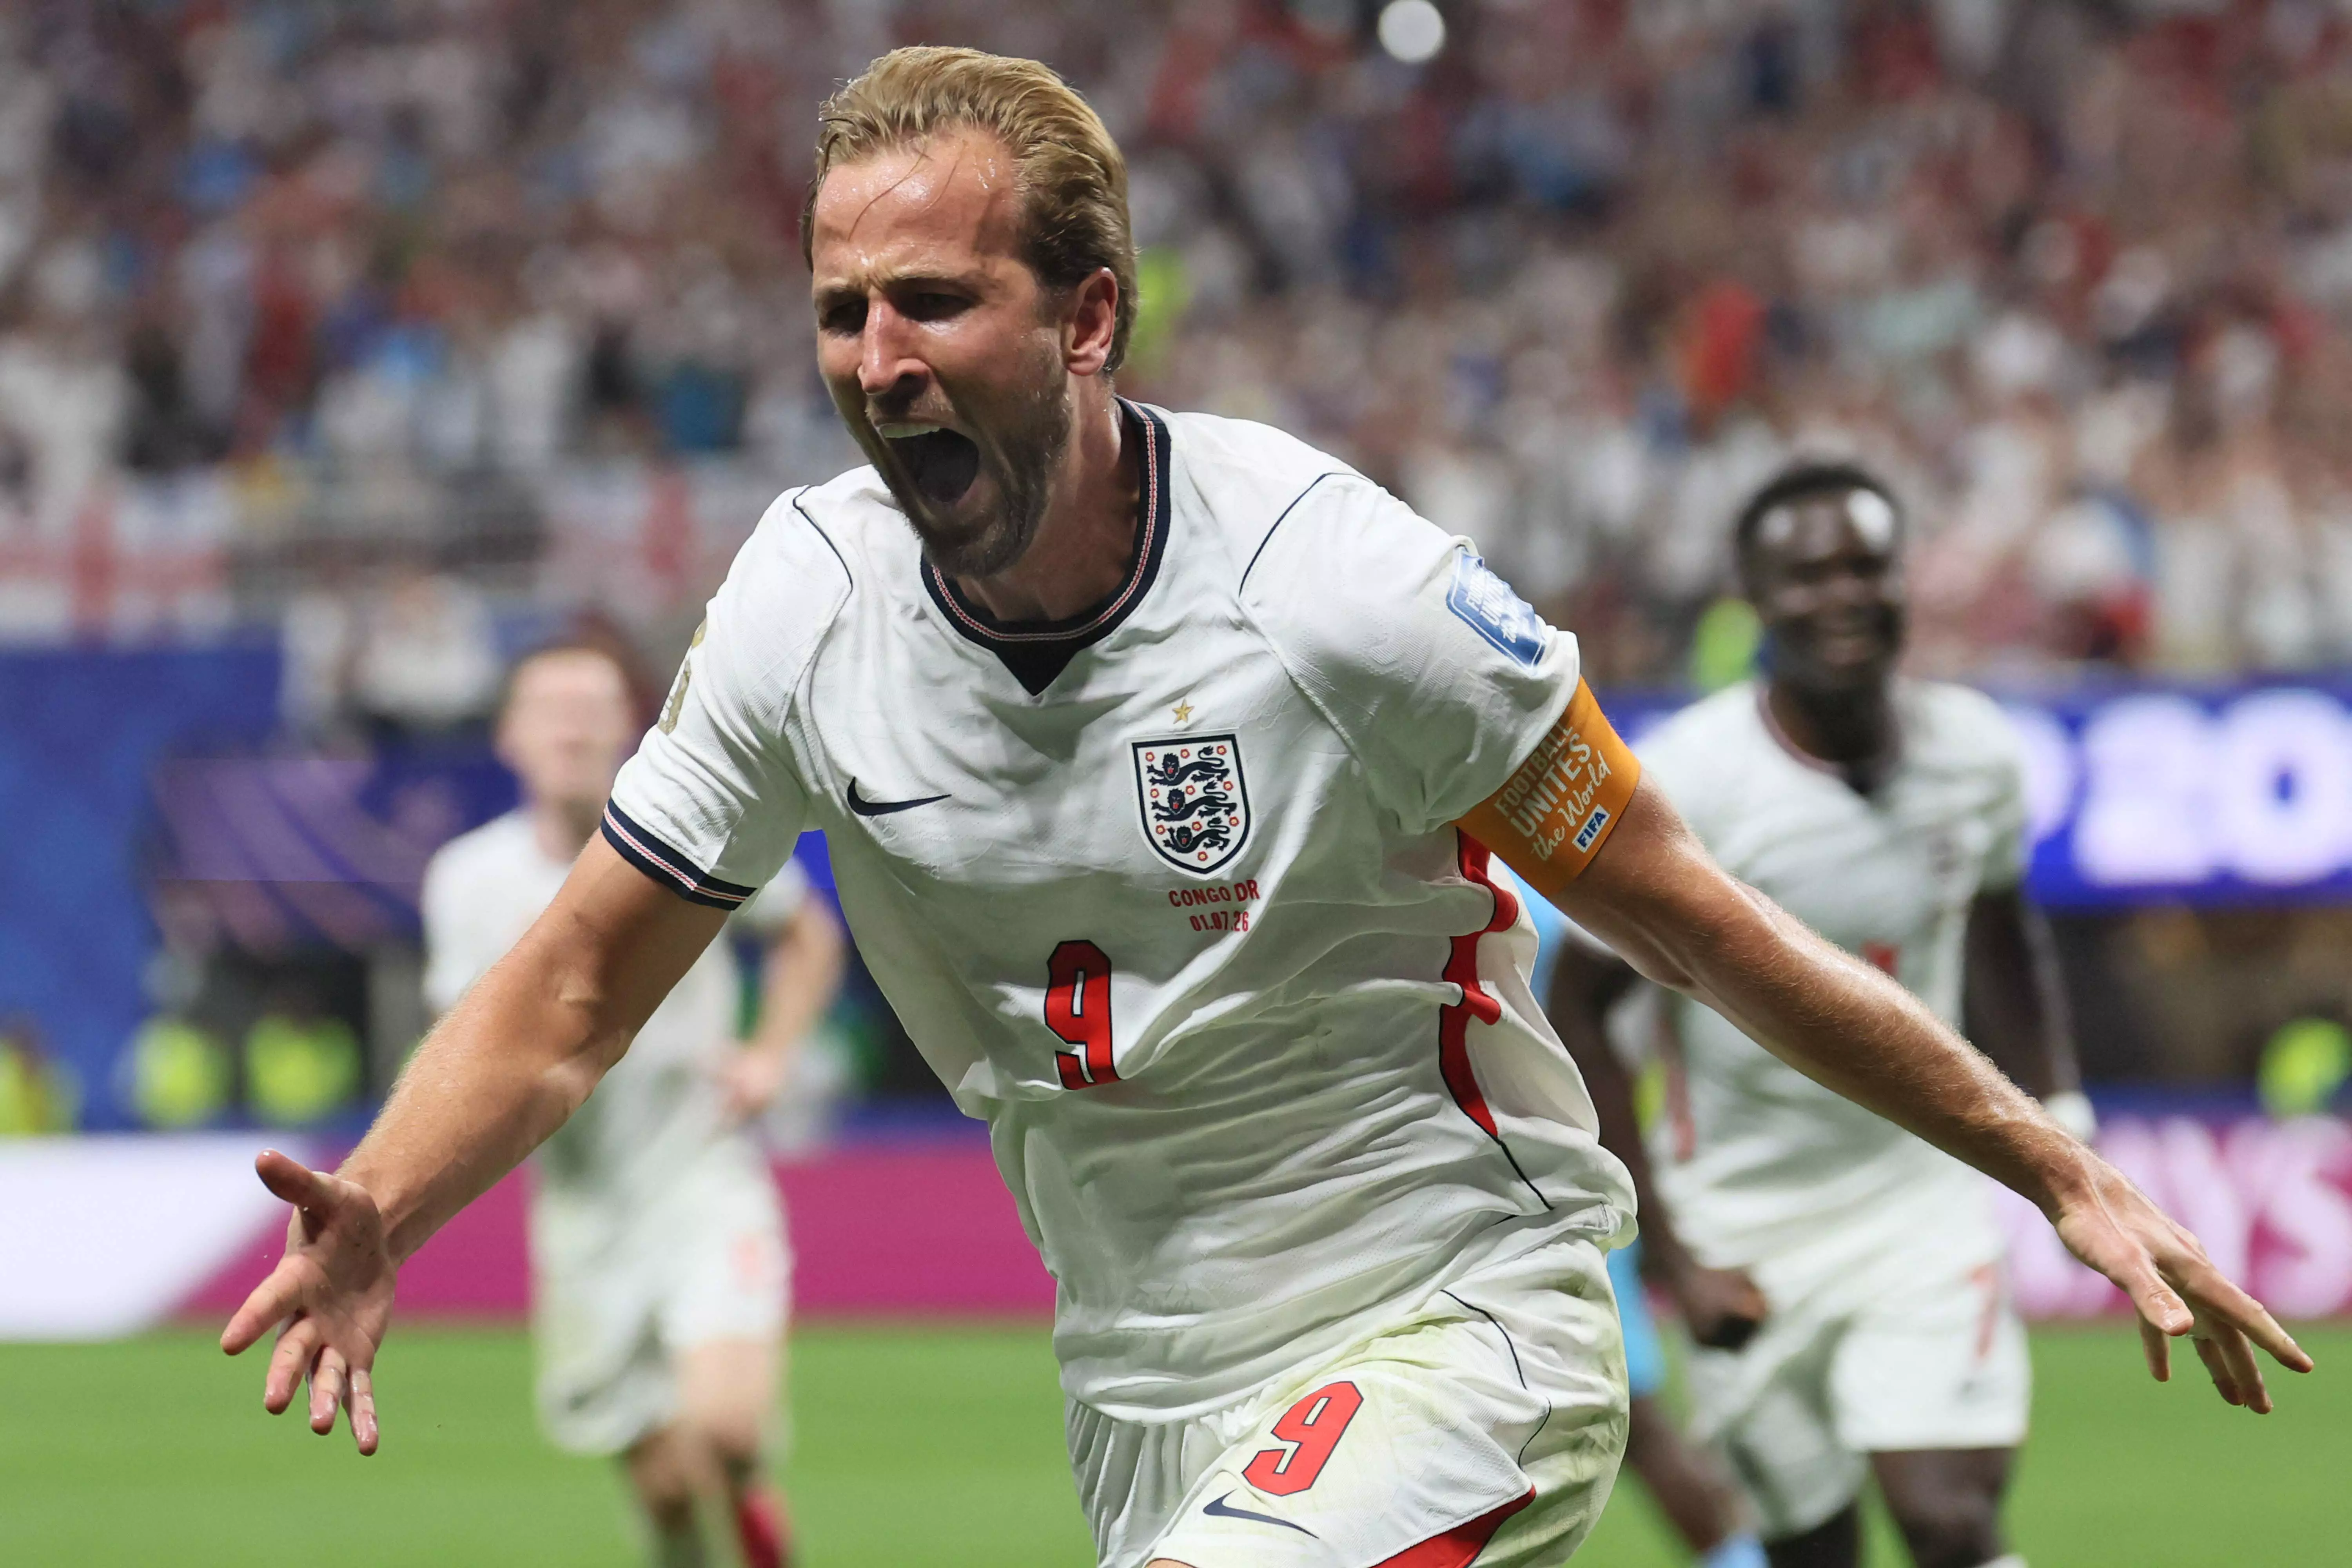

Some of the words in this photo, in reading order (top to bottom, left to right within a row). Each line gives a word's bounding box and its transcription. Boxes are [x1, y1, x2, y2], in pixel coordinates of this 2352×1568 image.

[1494, 721, 1573, 817] FOOTBALL
[1510, 733, 1591, 837] UNITES
[1530, 826, 1566, 861] the
[1557, 750, 1612, 827] World
[1577, 811, 1606, 848] FIFA
[1168, 886, 1232, 907] CONGO
[1234, 879, 1260, 902] DR
[1189, 910, 1249, 932] 01.07.26
[1044, 939, 1122, 1091] 9
[1241, 1380, 1364, 1497] 9
